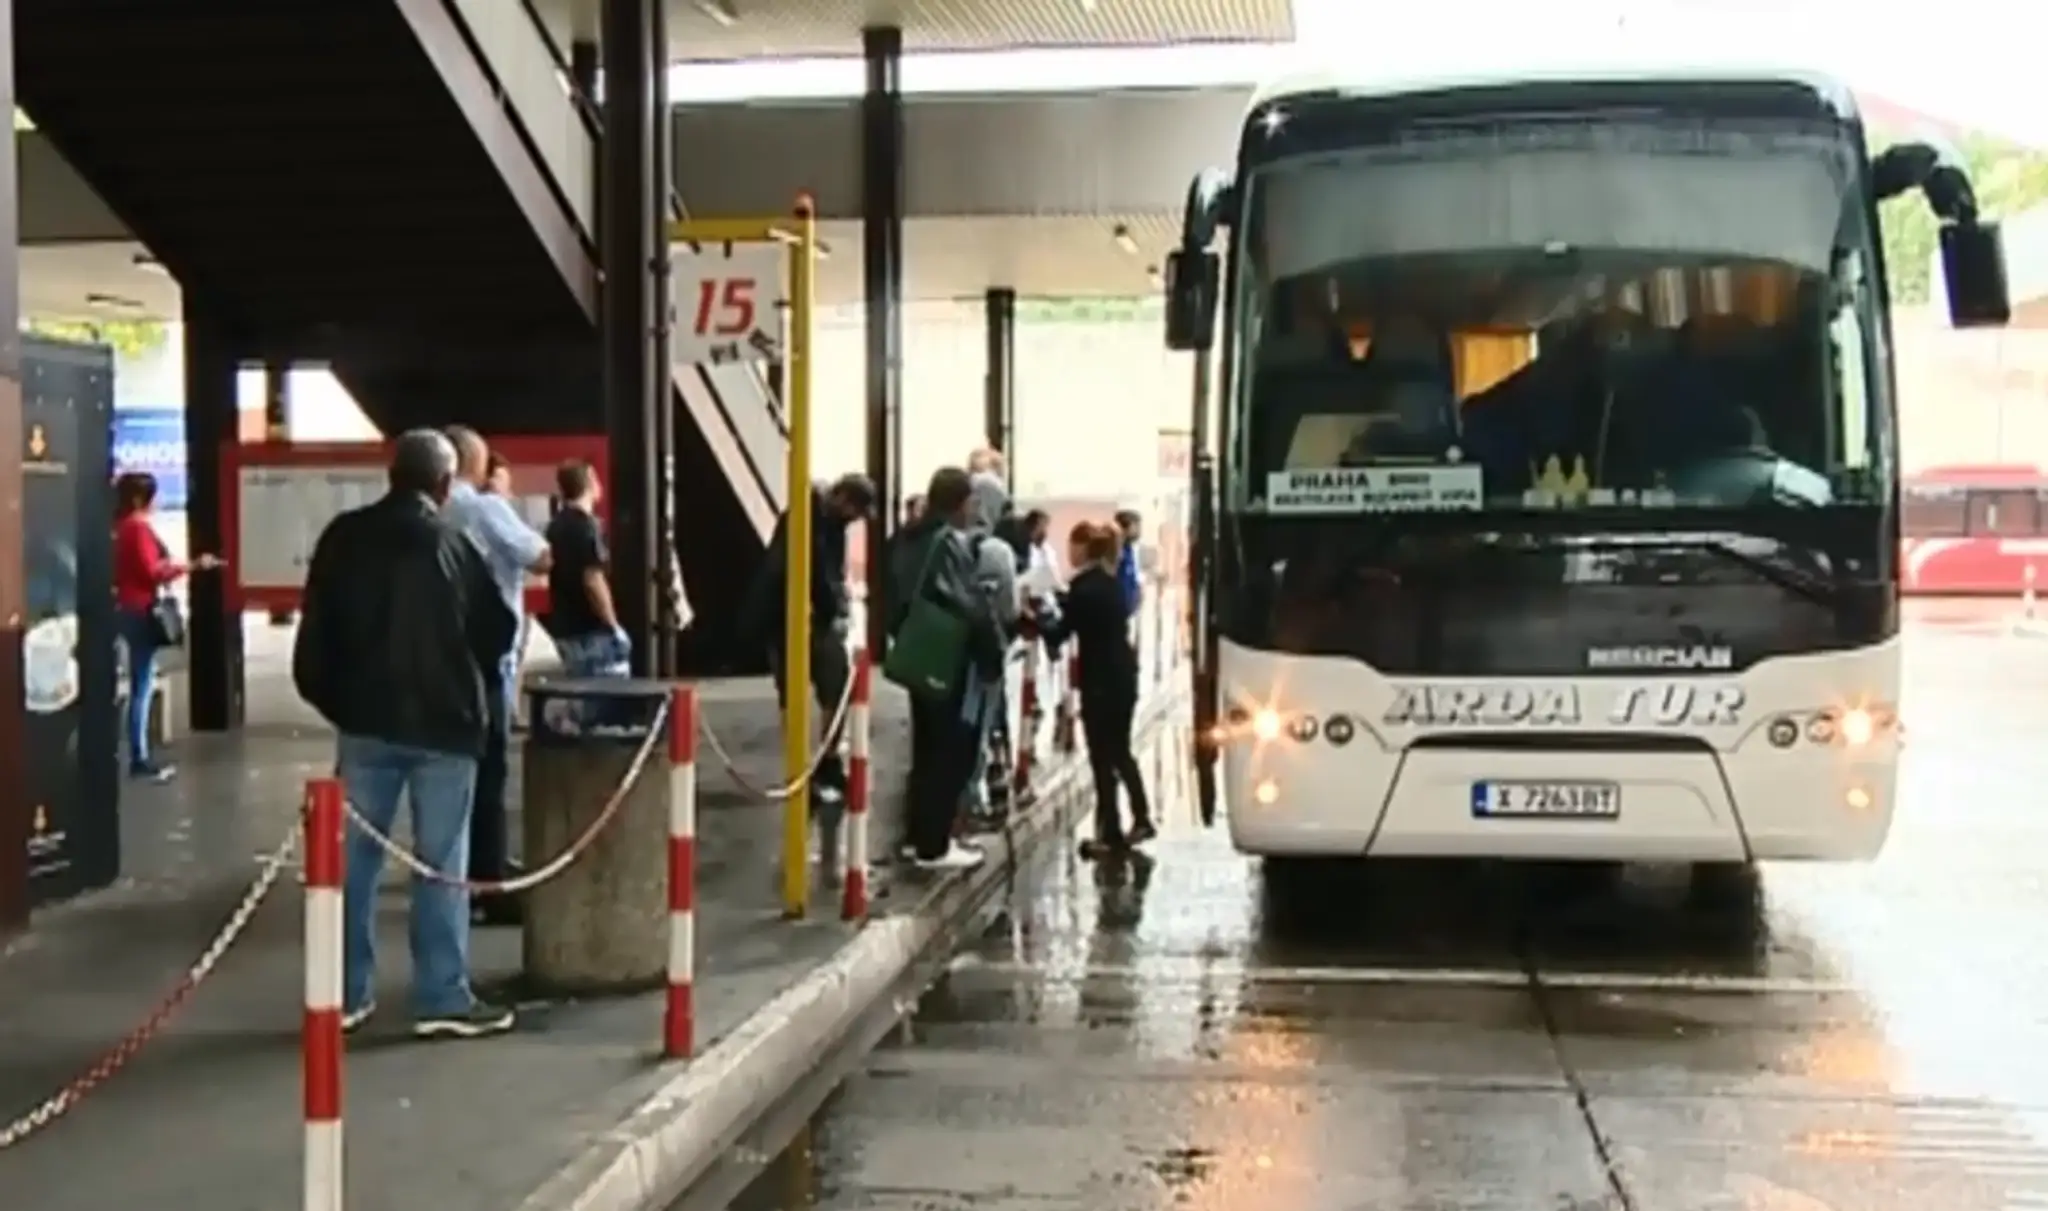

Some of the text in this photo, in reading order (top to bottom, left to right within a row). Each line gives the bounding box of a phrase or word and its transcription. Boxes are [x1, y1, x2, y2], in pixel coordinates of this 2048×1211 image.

[695, 279, 755, 335] 15
[1383, 682, 1746, 725] ARDA TUR
